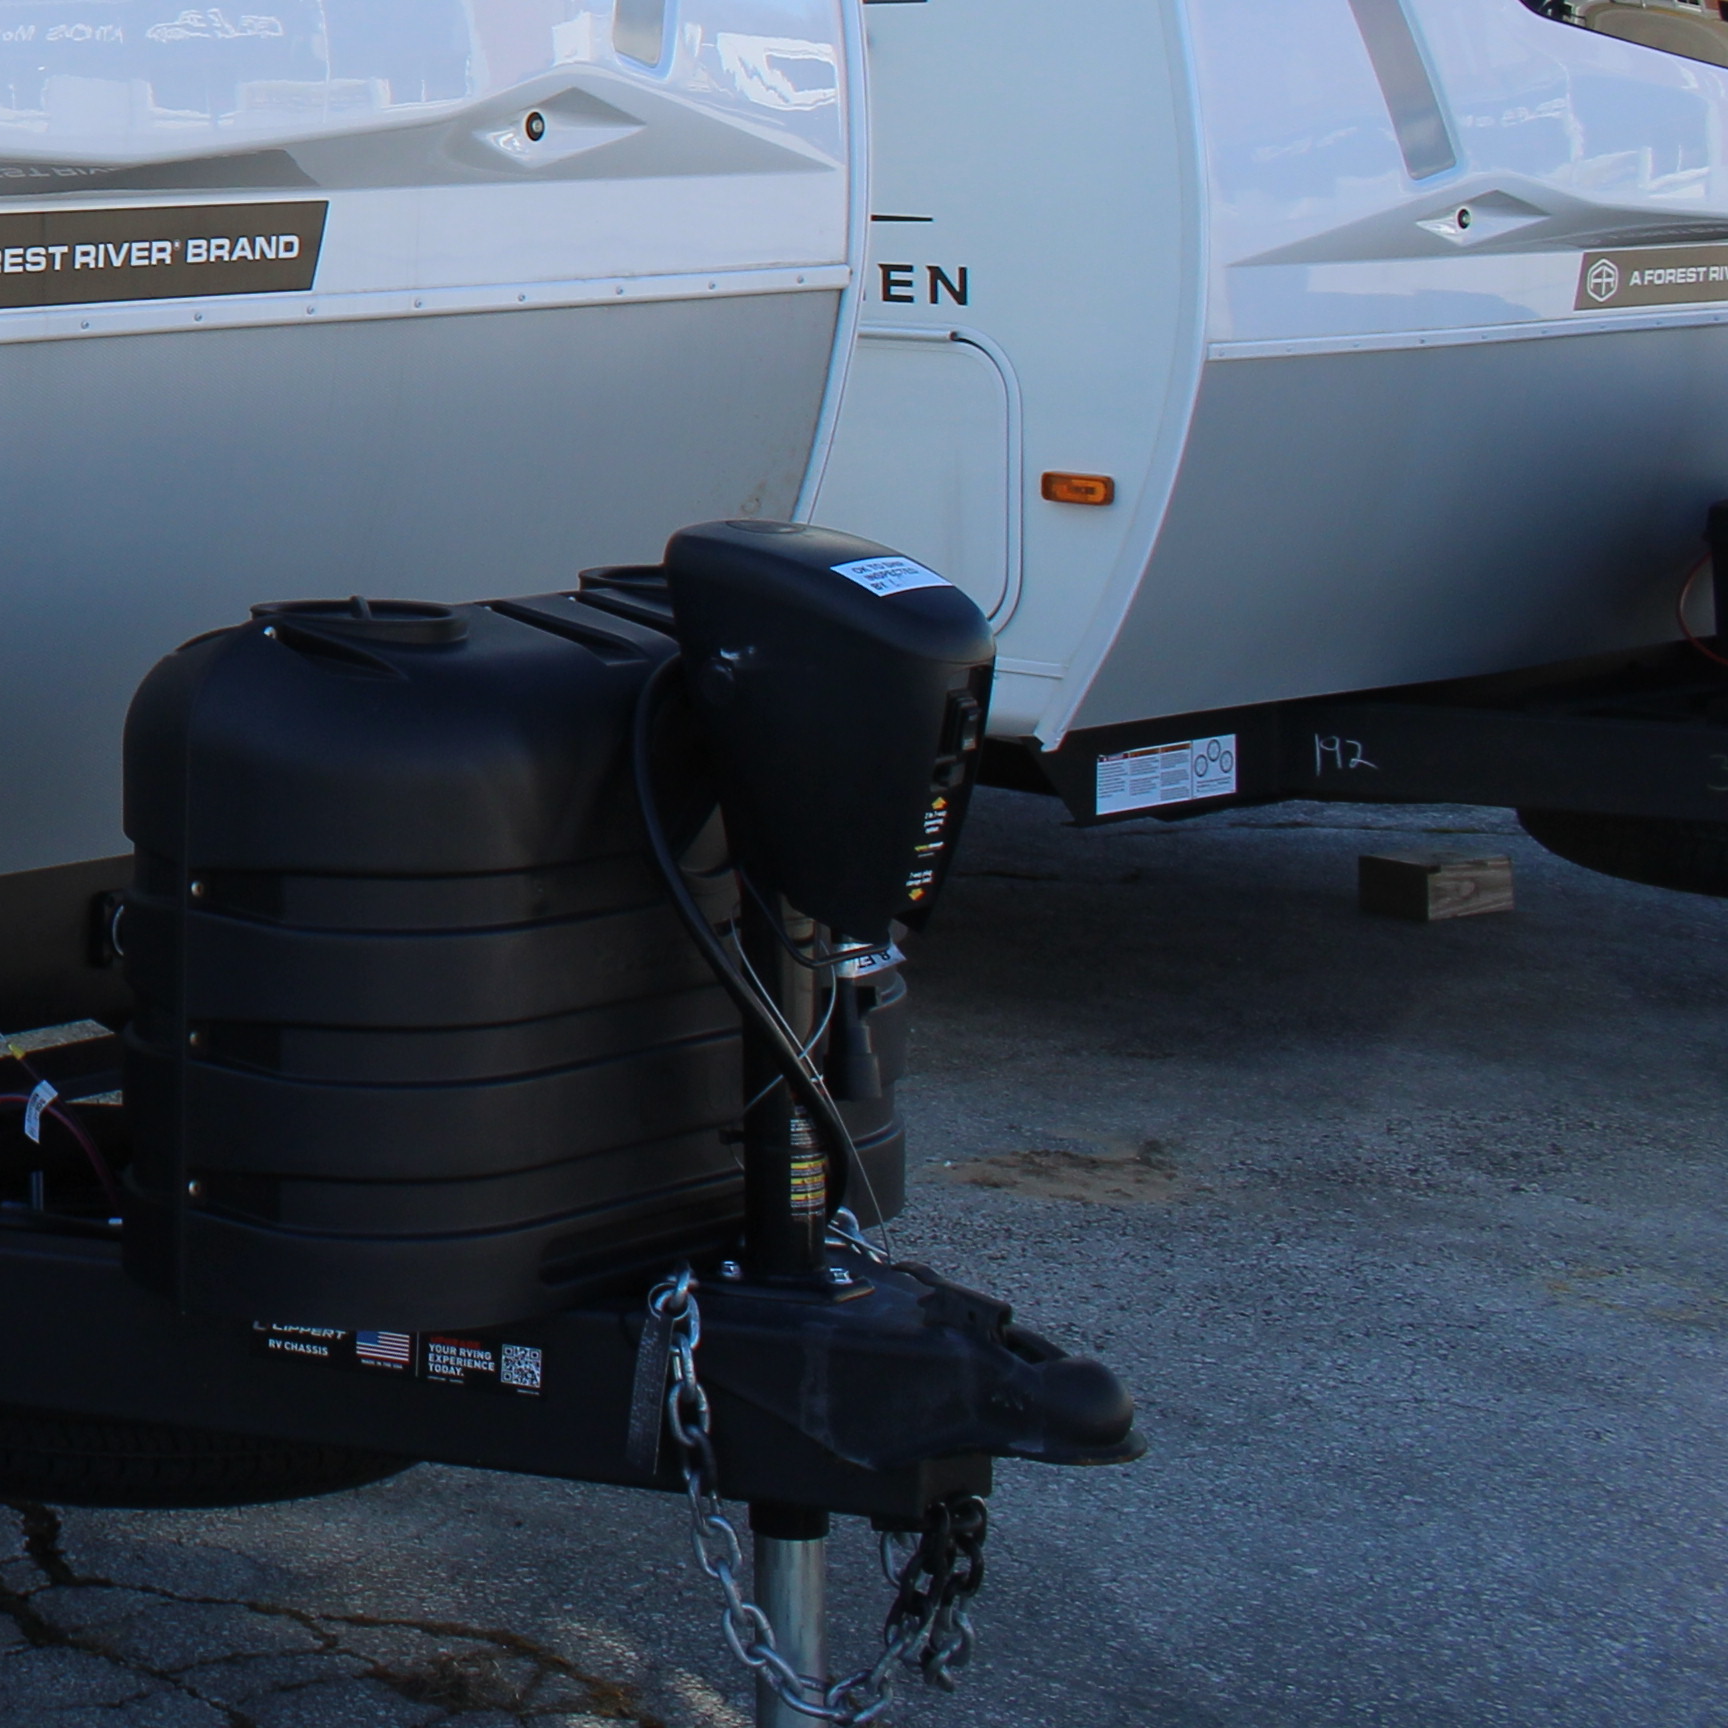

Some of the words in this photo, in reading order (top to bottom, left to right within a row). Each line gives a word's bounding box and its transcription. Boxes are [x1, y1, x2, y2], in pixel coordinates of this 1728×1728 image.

[185, 234, 300, 264] BRAND
[1629, 271, 1642, 287] A
[1644, 267, 1707, 285] FOREST
[268, 1338, 283, 1351] RV
[284, 1340, 329, 1357] CHASSIS
[428, 1343, 457, 1356] YOUR
[459, 1347, 493, 1361] RVING
[428, 1353, 496, 1372] EXPERIENCE
[428, 1363, 465, 1377] TODAY.
